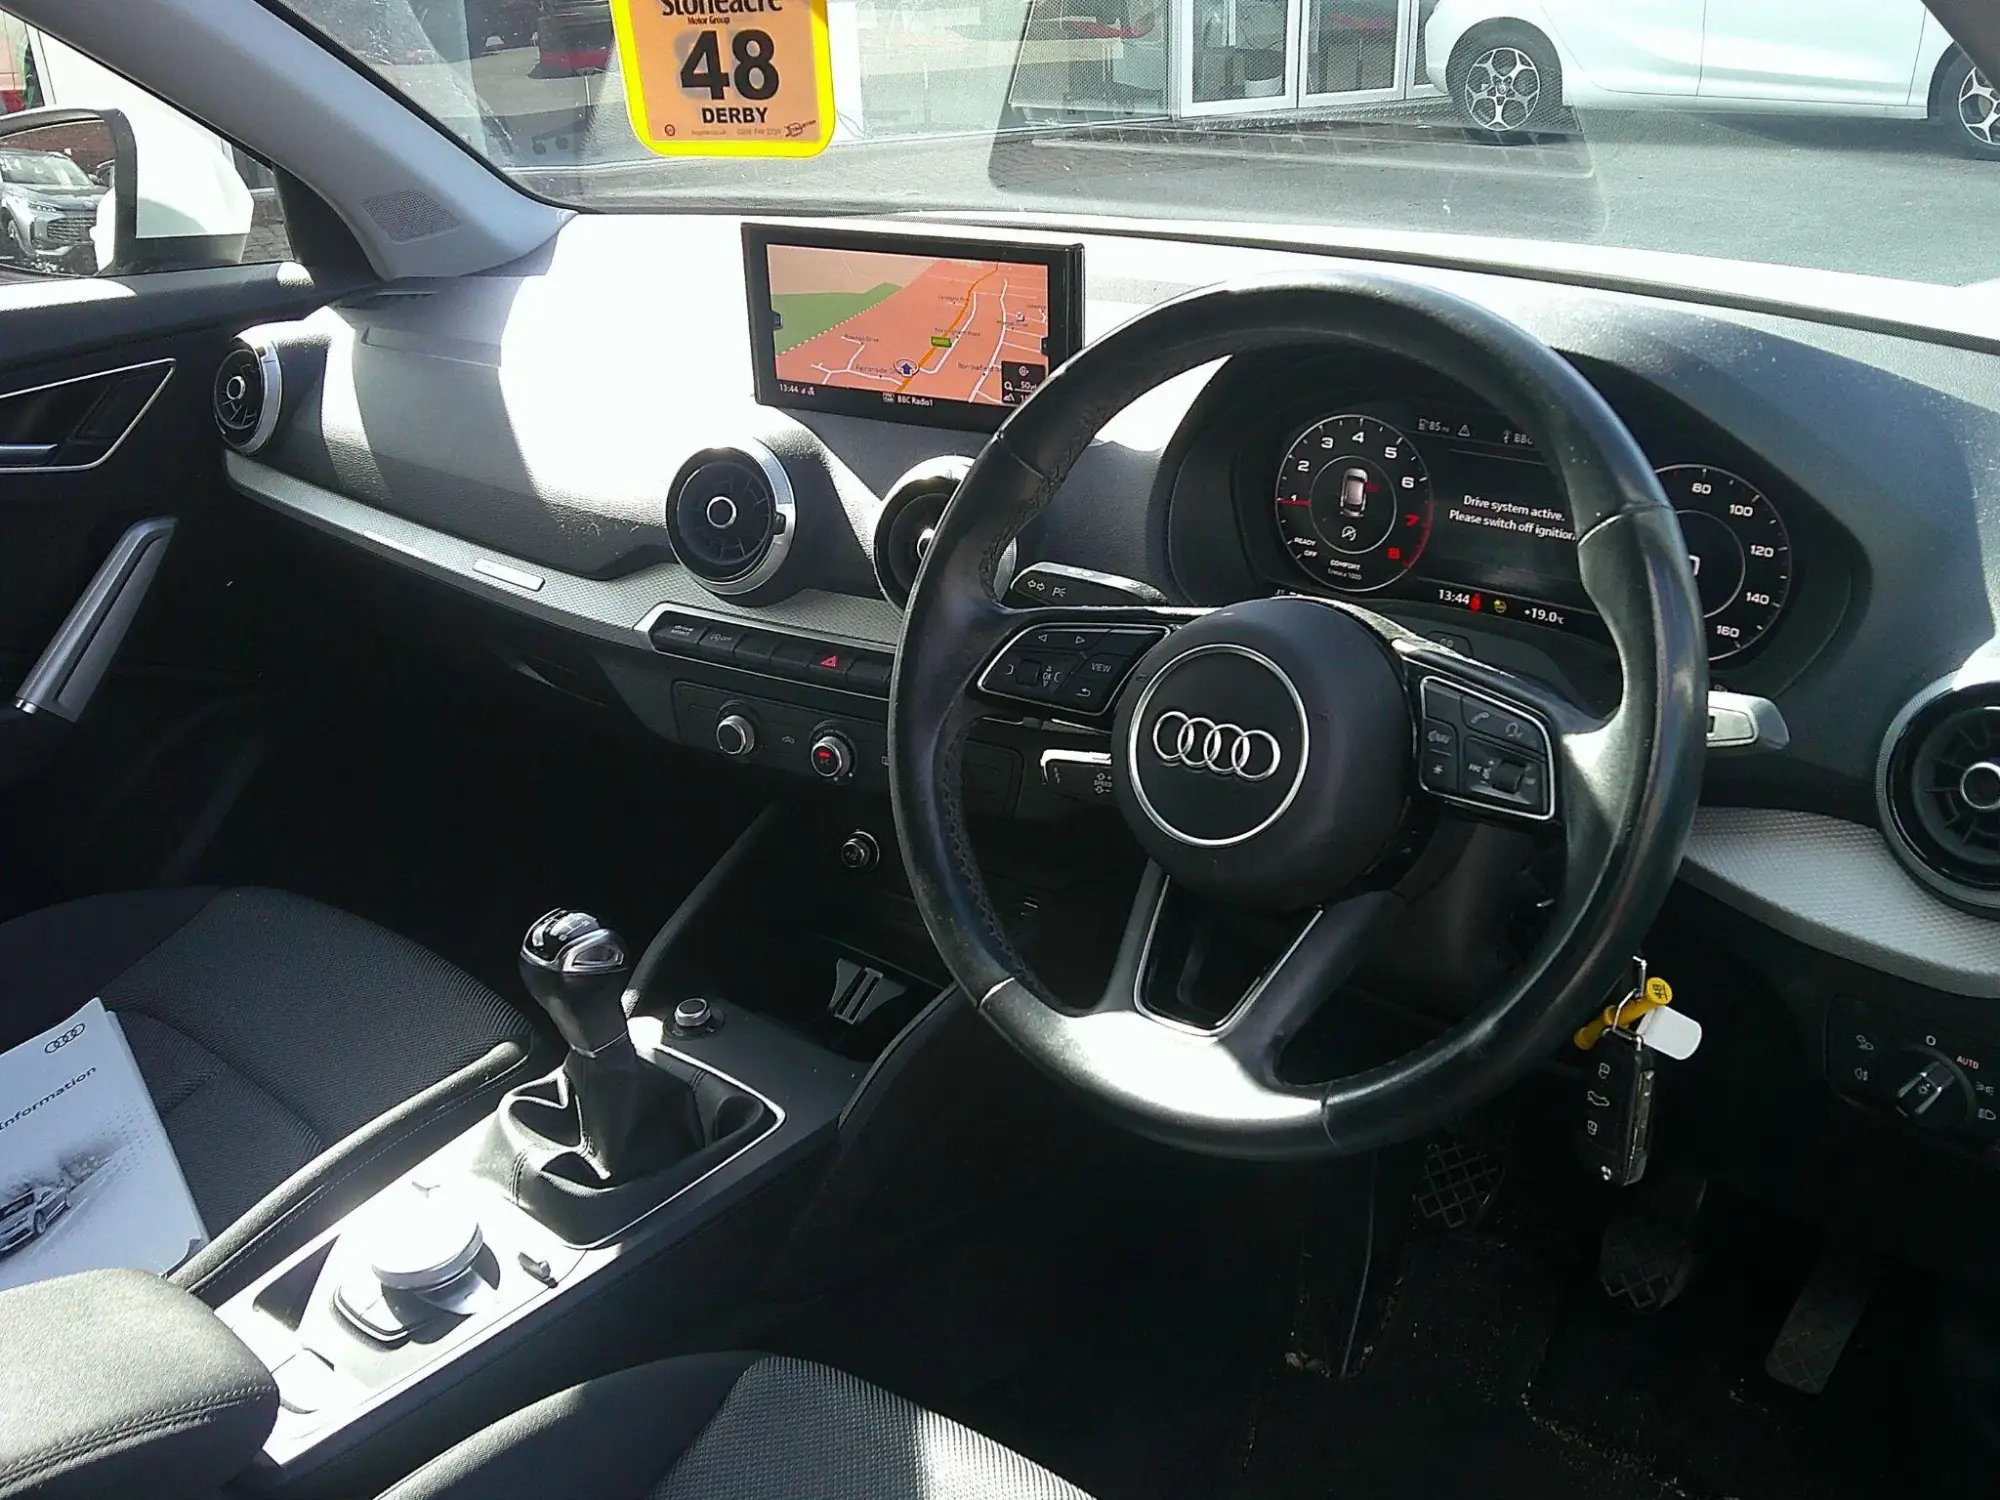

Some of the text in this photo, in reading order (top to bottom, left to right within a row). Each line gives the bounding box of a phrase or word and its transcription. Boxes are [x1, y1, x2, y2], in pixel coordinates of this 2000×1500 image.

[687, 15, 731, 25] Motor Group
[680, 30, 779, 100] 48
[701, 106, 769, 124] DERBY
[779, 384, 800, 394] 13:44
[897, 395, 911, 404] BBC
[1321, 437, 1334, 449] 3
[1352, 432, 1364, 443] 4
[1385, 447, 1397, 459] 5
[1297, 460, 1310, 472] 2
[1402, 477, 1414, 489] 6
[1691, 482, 1712, 495] 80
[1463, 494, 1565, 521] Drive system active.
[1729, 503, 1753, 517] 100
[1405, 514, 1419, 526] 7
[1449, 509, 1481, 524] Please
[1482, 517, 1517, 531] switch
[1518, 522, 1534, 533] off
[1294, 537, 1316, 546] READY
[1303, 549, 1318, 557] OFF
[1750, 544, 1774, 558] 120
[1330, 559, 1361, 571] COMFORT
[1438, 589, 1470, 605] 13:44
[1746, 591, 1770, 605] 140
[1716, 624, 1740, 639] 160
[1092, 662, 1112, 673] VIEW
[1956, 1055, 1980, 1070] AUTO
[0, 1066, 97, 1131] Information
